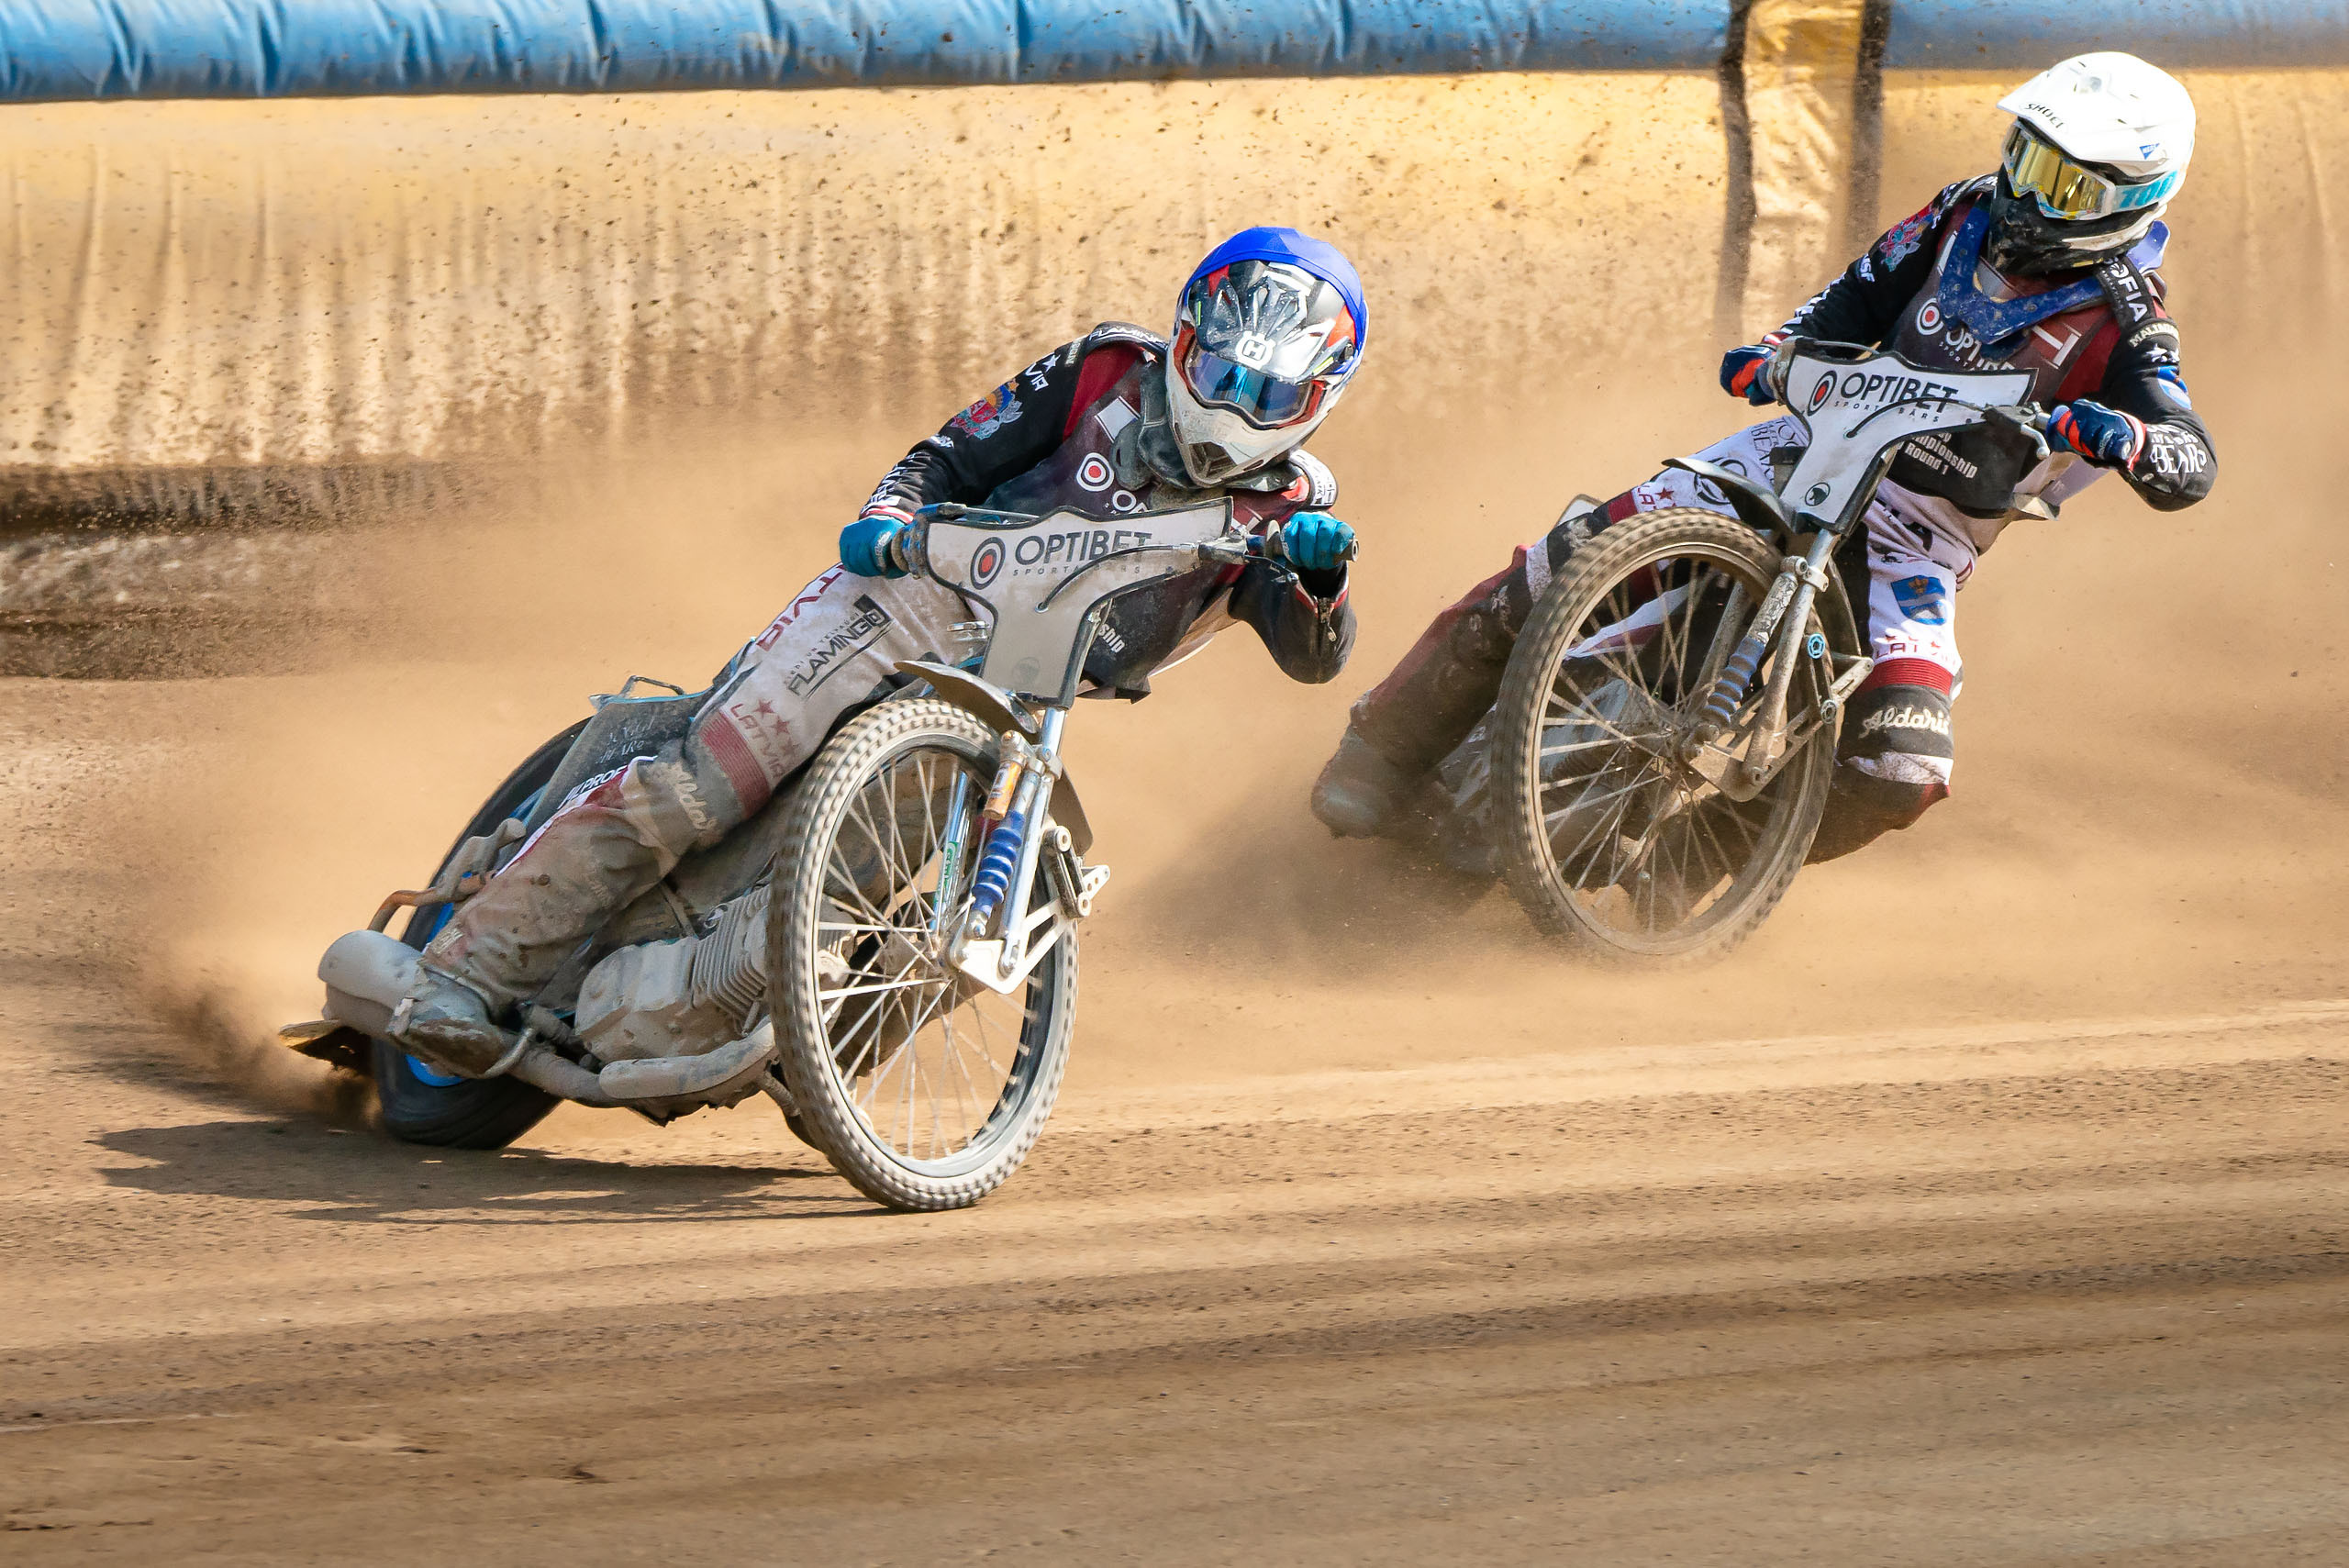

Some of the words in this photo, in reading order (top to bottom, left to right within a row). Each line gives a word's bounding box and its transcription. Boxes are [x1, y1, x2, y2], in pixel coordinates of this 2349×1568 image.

[2024, 103, 2065, 128] SHOEI
[1841, 373, 1959, 413] OPTIBET
[1015, 529, 1152, 565] OPTIBET
[786, 606, 891, 697] FLAMINGO
